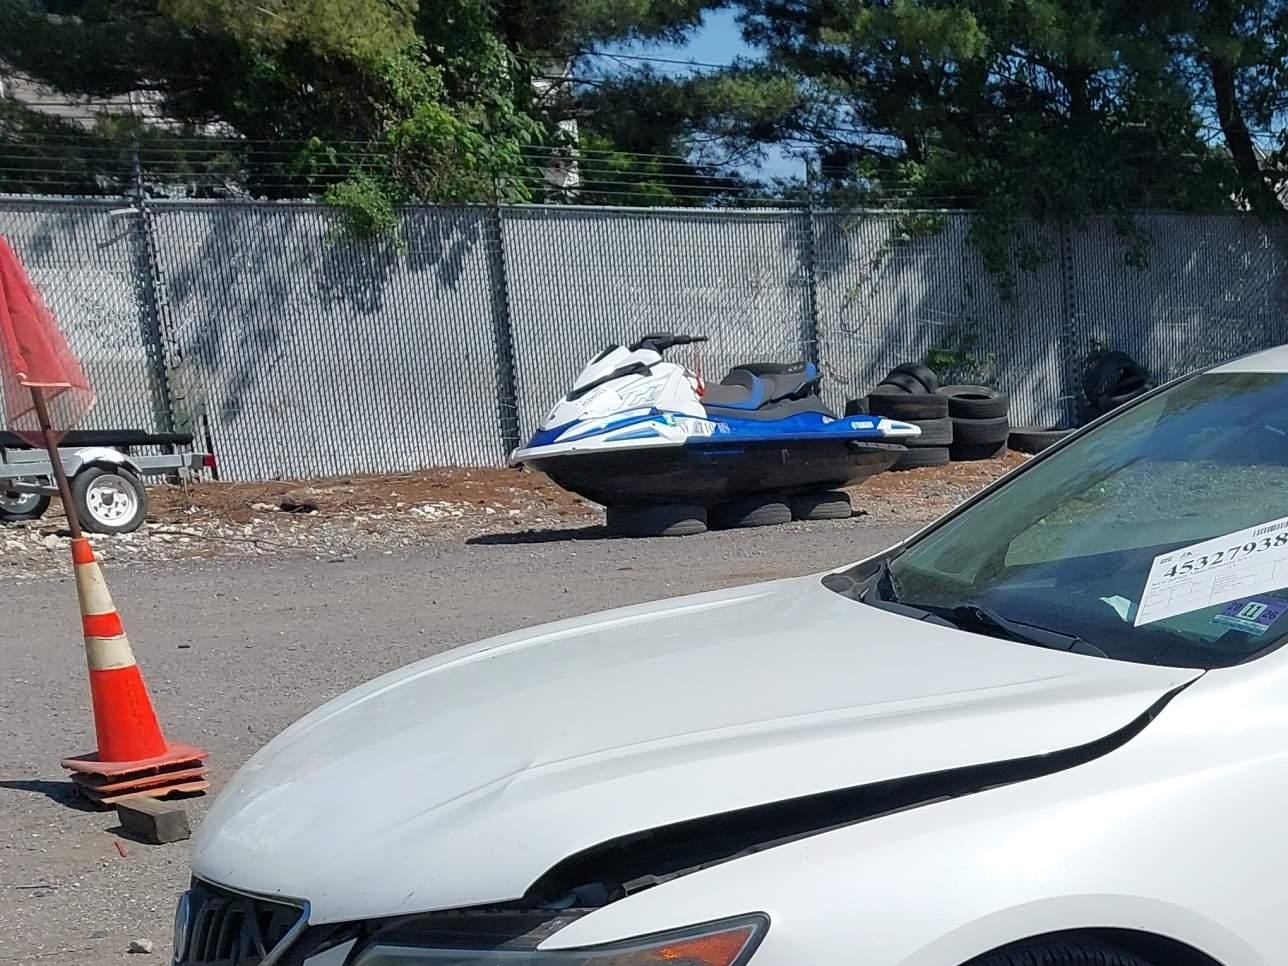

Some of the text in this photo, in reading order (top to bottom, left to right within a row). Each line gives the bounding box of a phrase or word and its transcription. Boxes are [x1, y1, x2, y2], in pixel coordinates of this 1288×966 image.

[1163, 532, 1288, 579] 45327938
[1241, 604, 1261, 618] 11
[1261, 610, 1279, 619] 26
